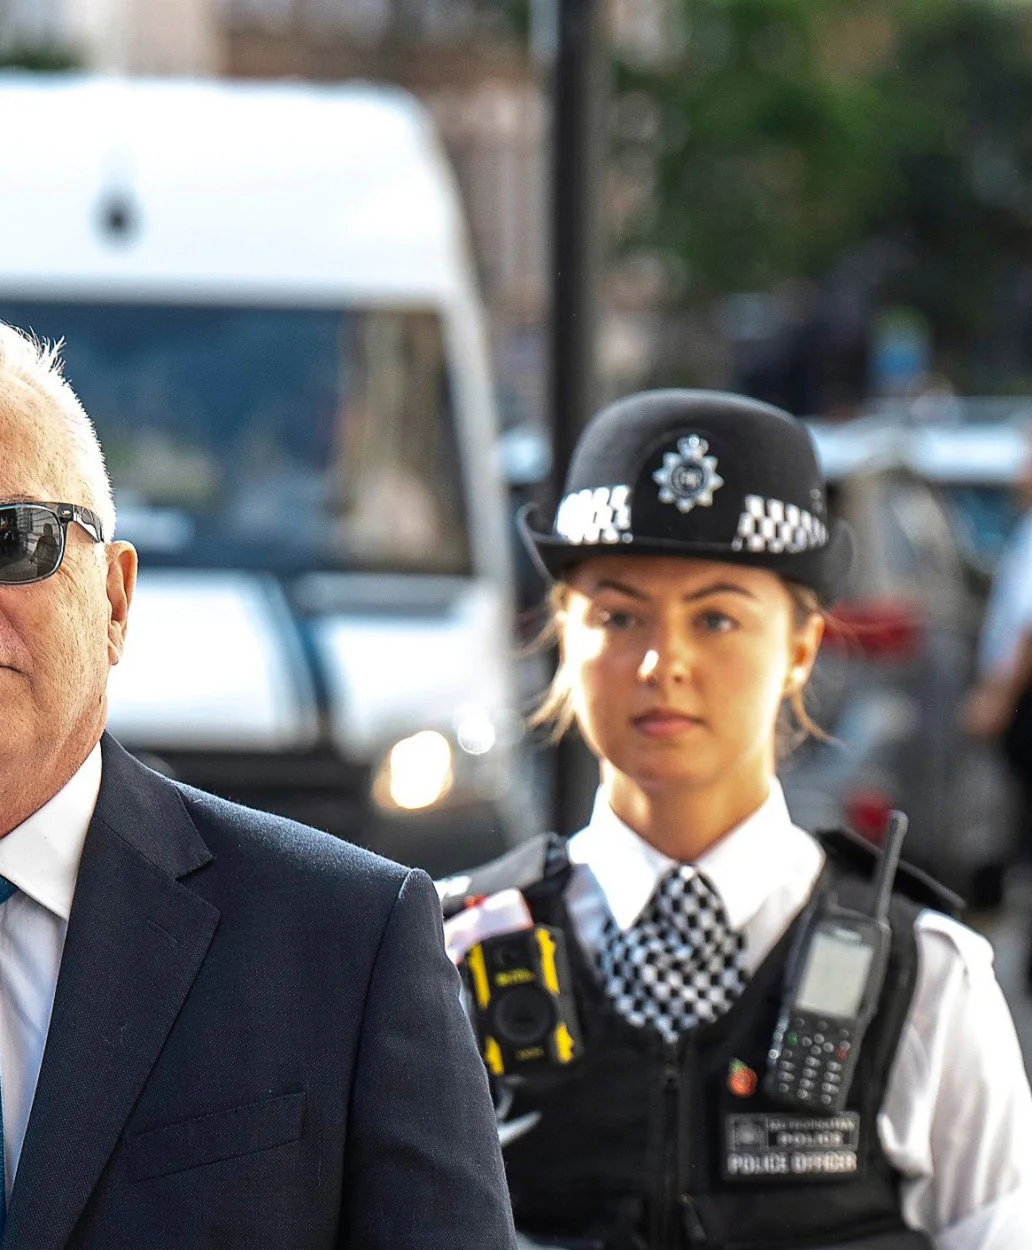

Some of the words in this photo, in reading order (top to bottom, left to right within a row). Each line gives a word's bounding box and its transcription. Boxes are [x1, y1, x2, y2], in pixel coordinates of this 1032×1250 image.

[777, 1131, 844, 1147] POLICE
[728, 1153, 788, 1174] POLICE
[791, 1152, 857, 1173] OFFICER
